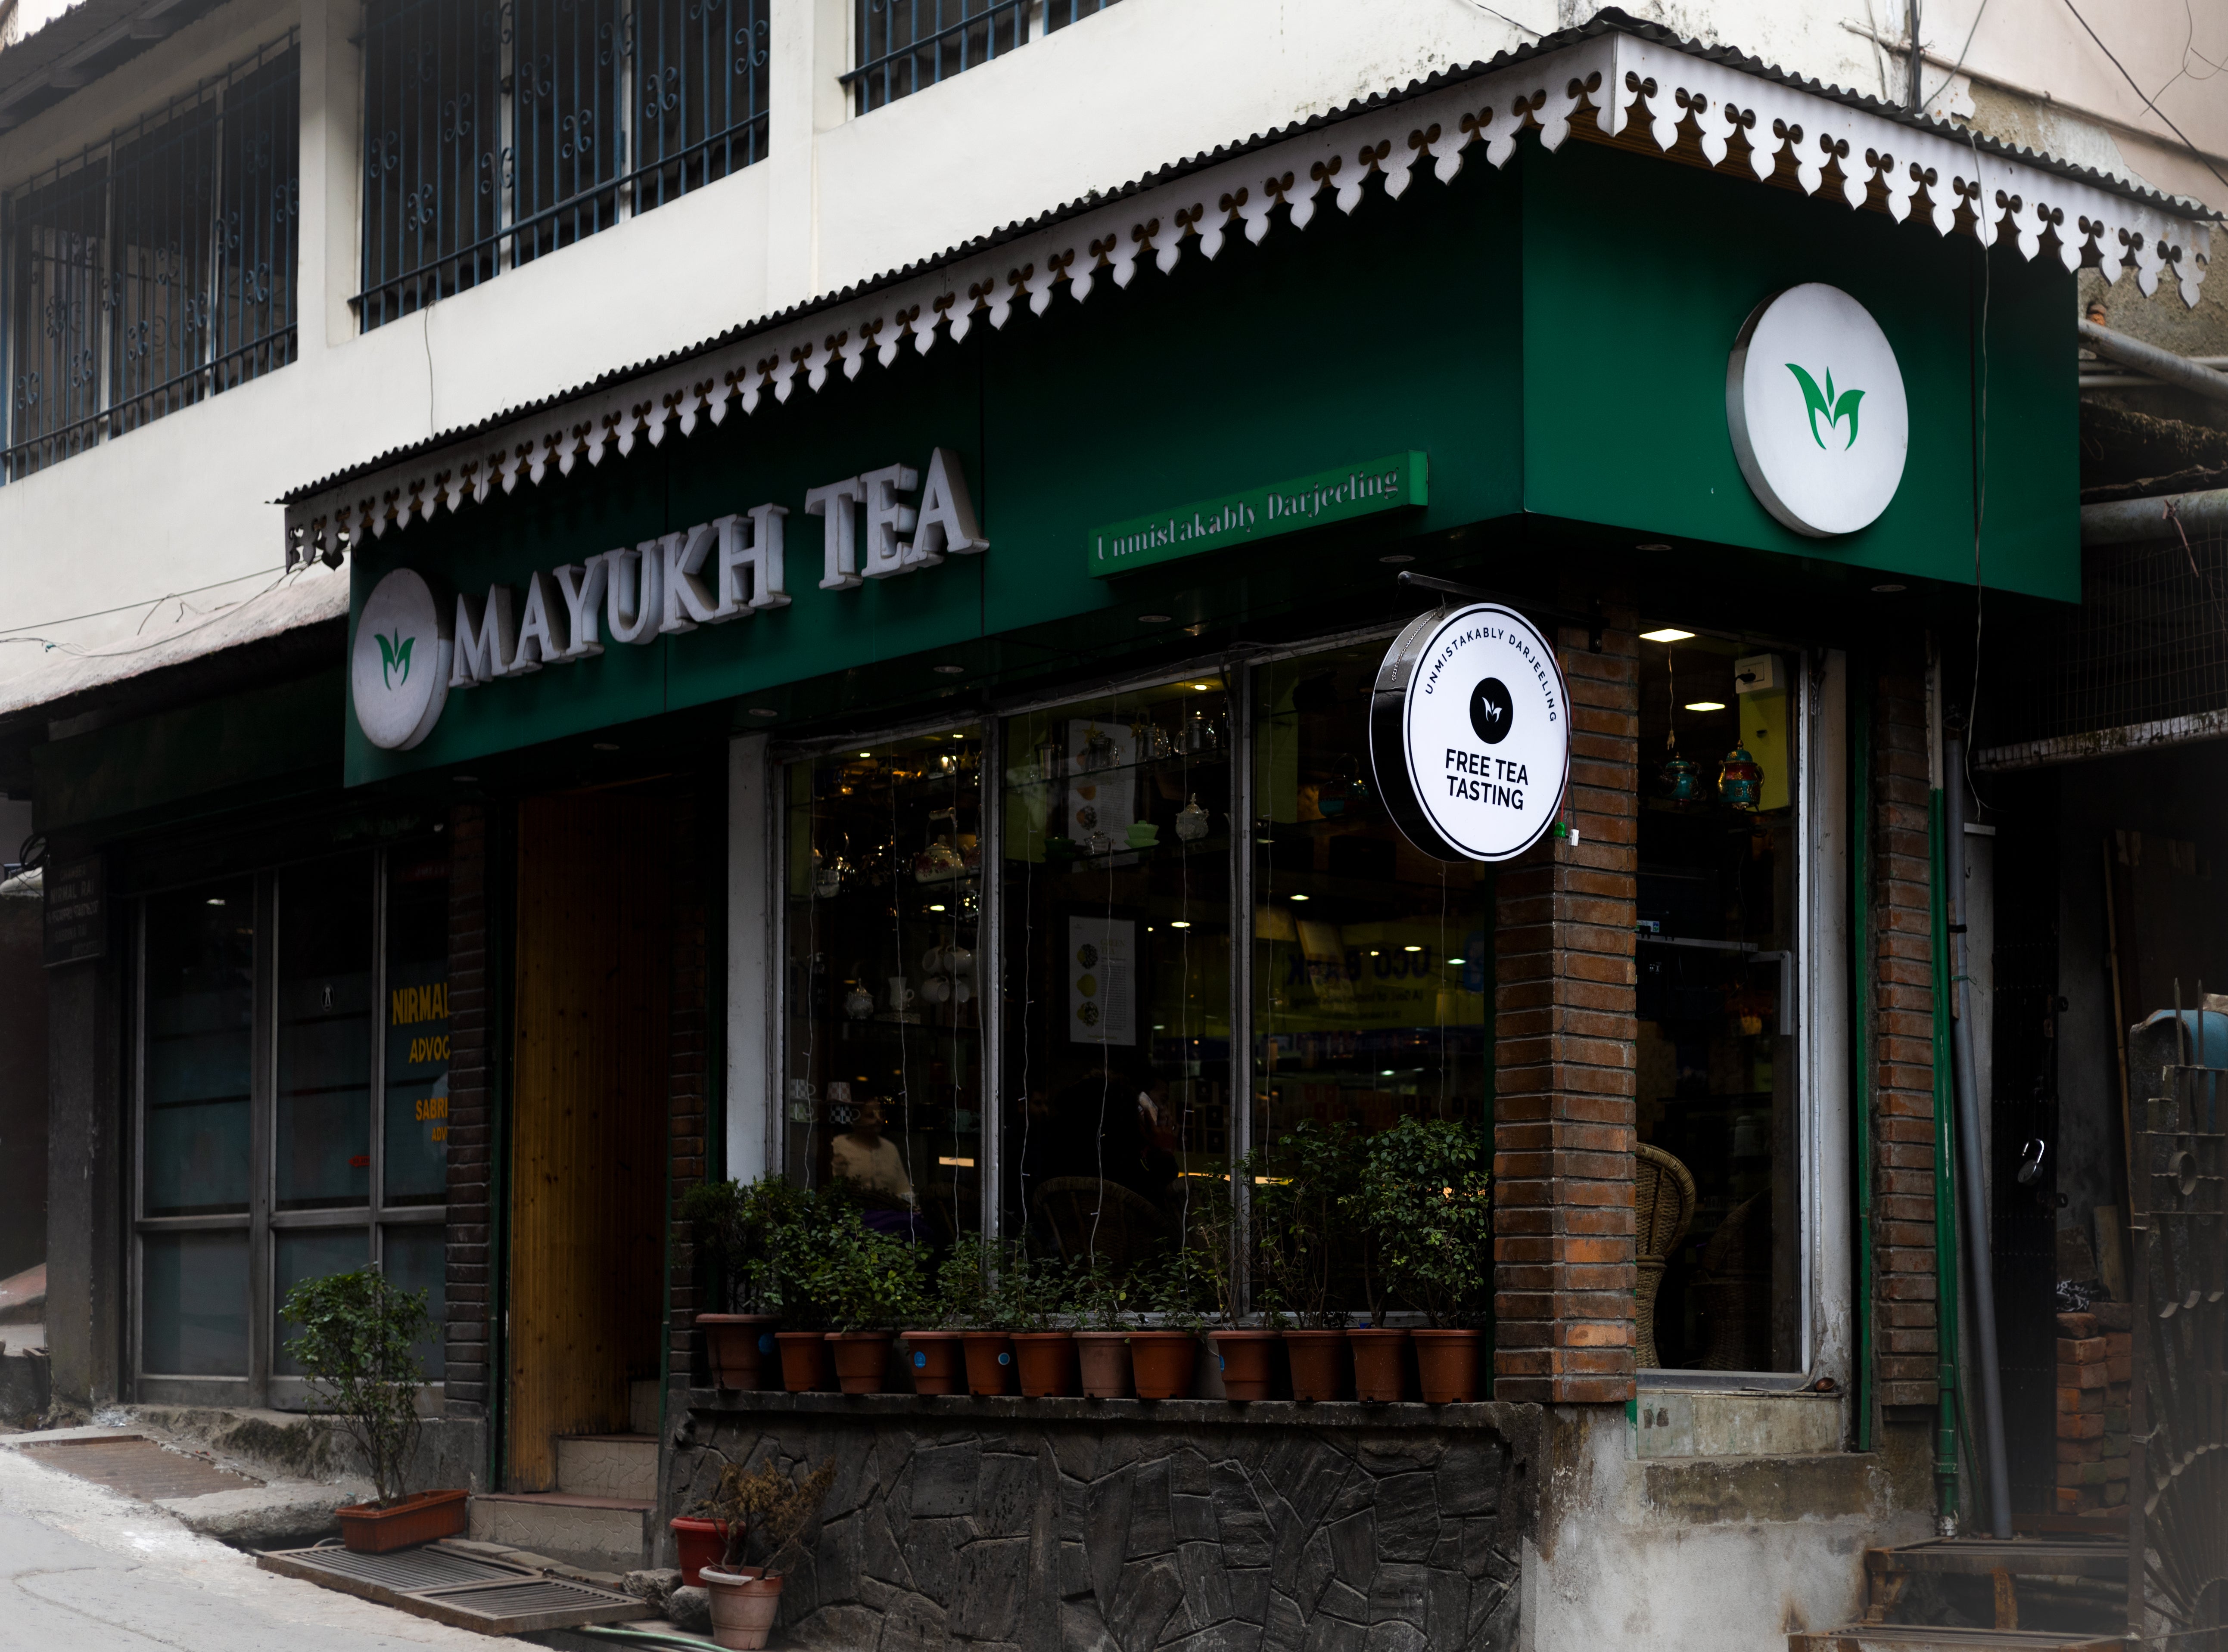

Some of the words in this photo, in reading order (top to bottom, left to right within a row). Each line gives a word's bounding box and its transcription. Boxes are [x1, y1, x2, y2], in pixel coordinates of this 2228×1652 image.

[1097, 500, 1259, 561] Unmistakably
[1267, 466, 1399, 518] Darjeeling
[448, 502, 792, 689] MAYUKH
[804, 446, 990, 591] TEA
[1425, 627, 1504, 695] UNMISTAKABLY
[1509, 634, 1556, 722] DARJEELING
[1446, 748, 1491, 777] FREE
[1495, 758, 1528, 786] TEA
[1447, 775, 1523, 810] TASTING
[50, 882, 77, 904] NIRMAL
